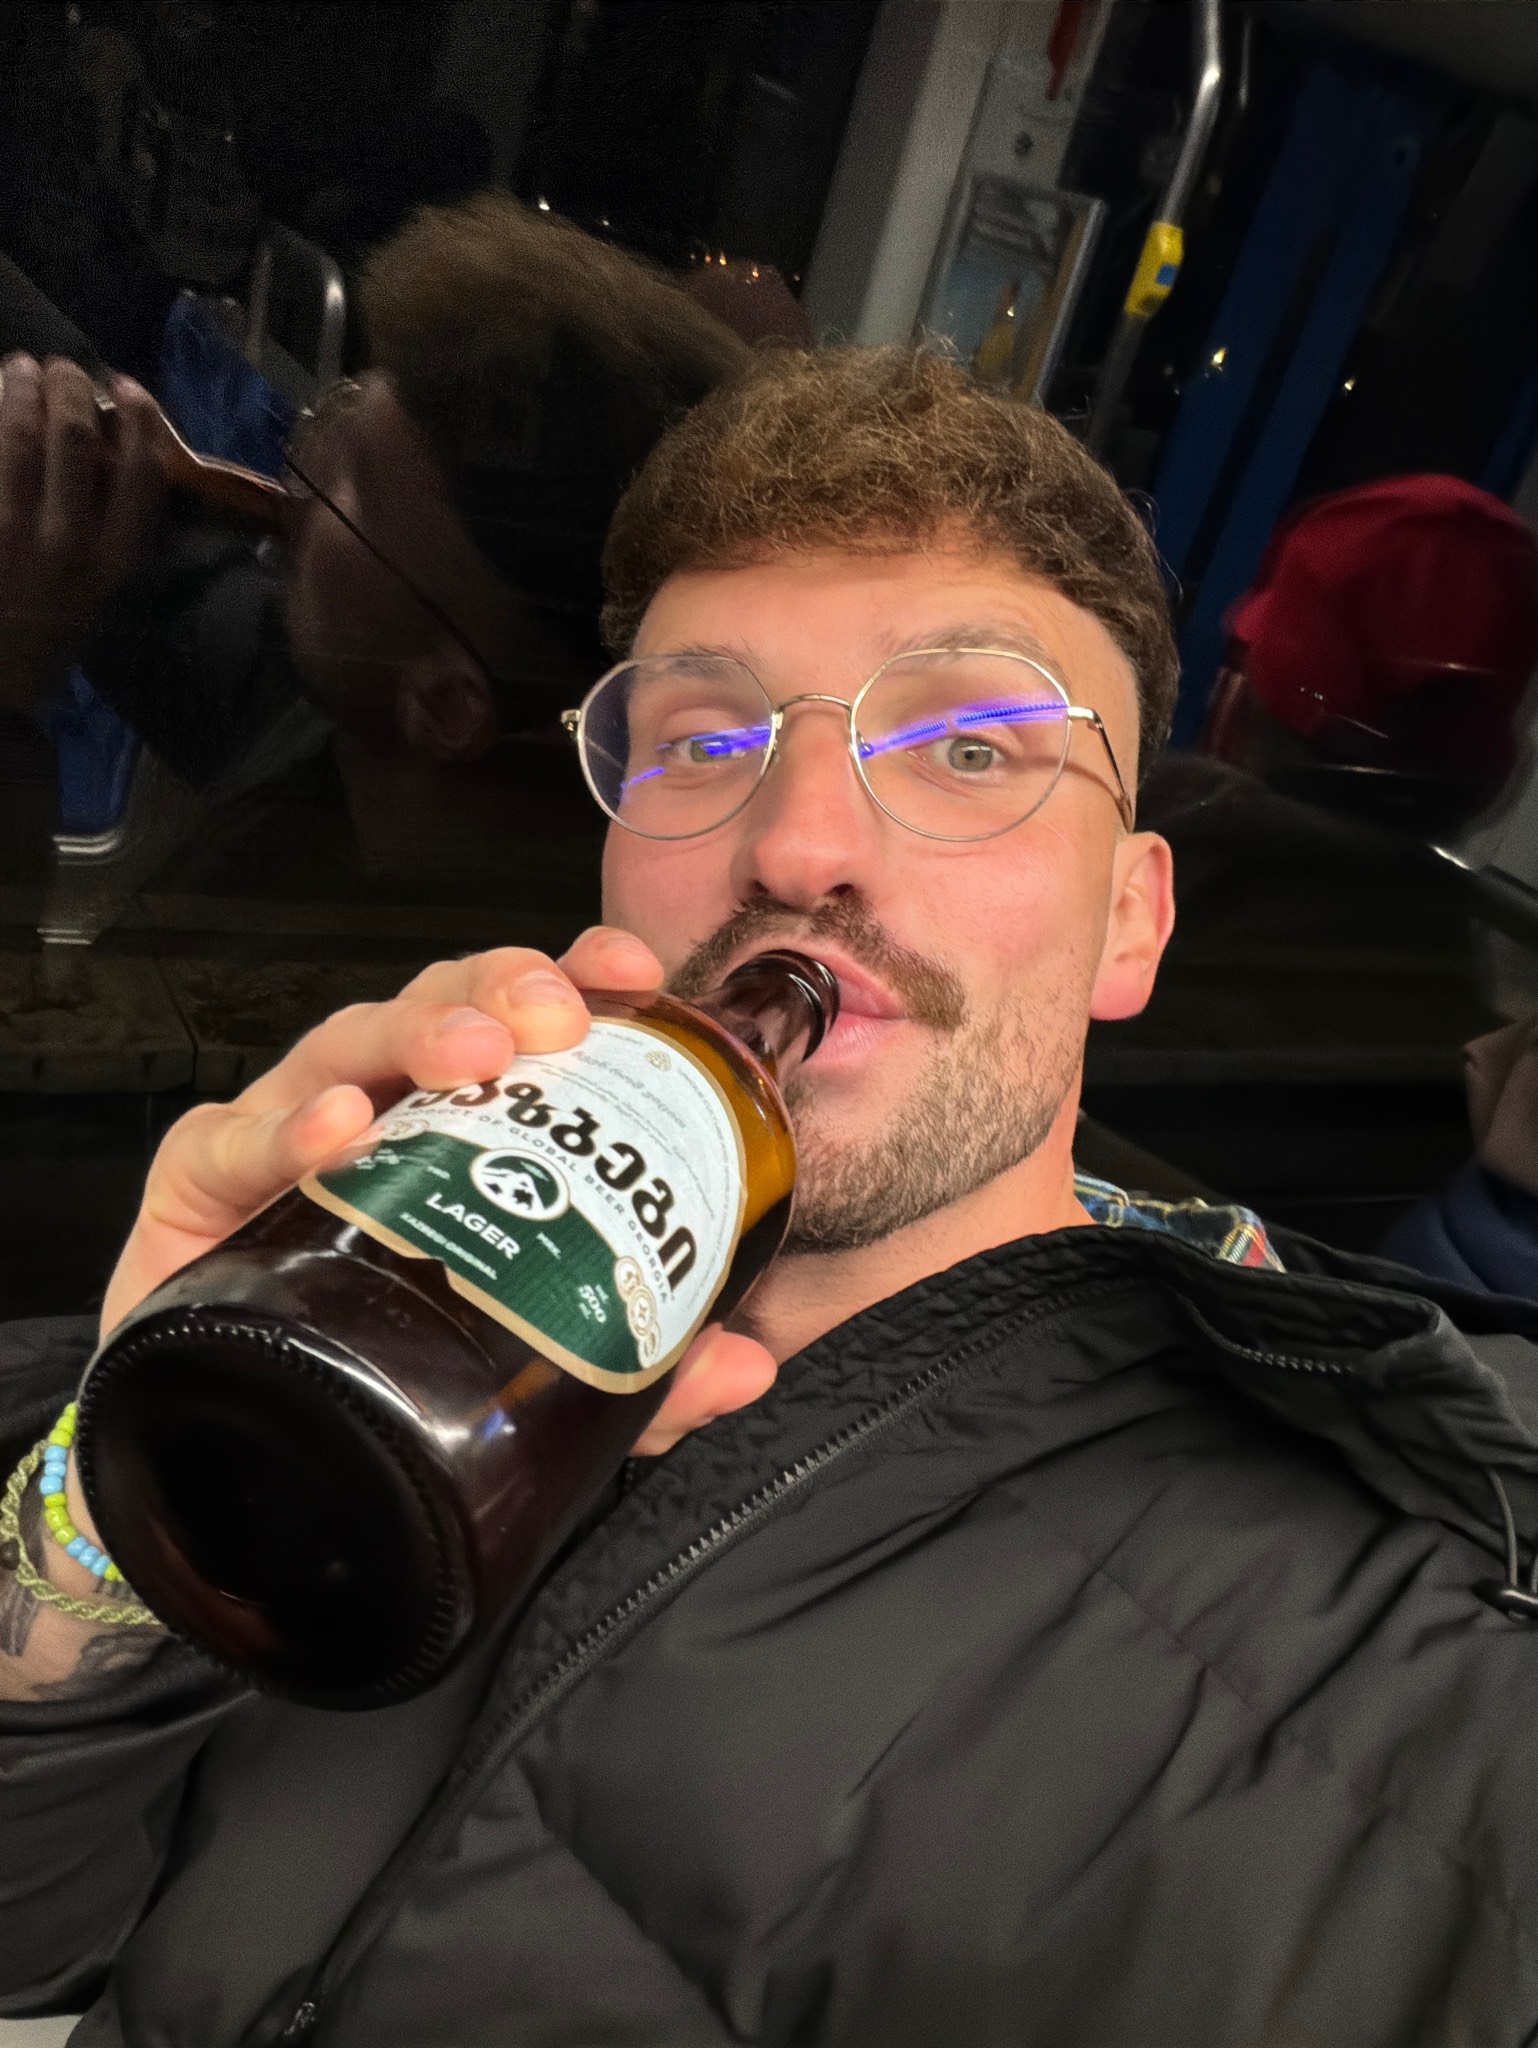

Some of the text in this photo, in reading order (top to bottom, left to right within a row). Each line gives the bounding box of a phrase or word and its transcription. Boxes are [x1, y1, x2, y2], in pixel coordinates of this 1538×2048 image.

[425, 1192, 520, 1260] LAGER
[478, 1114, 505, 1125] OF
[509, 1126, 577, 1172] GLOBAL
[584, 1174, 625, 1215] BEER
[628, 1220, 669, 1303] GEORGIA
[578, 1284, 607, 1323] 500
